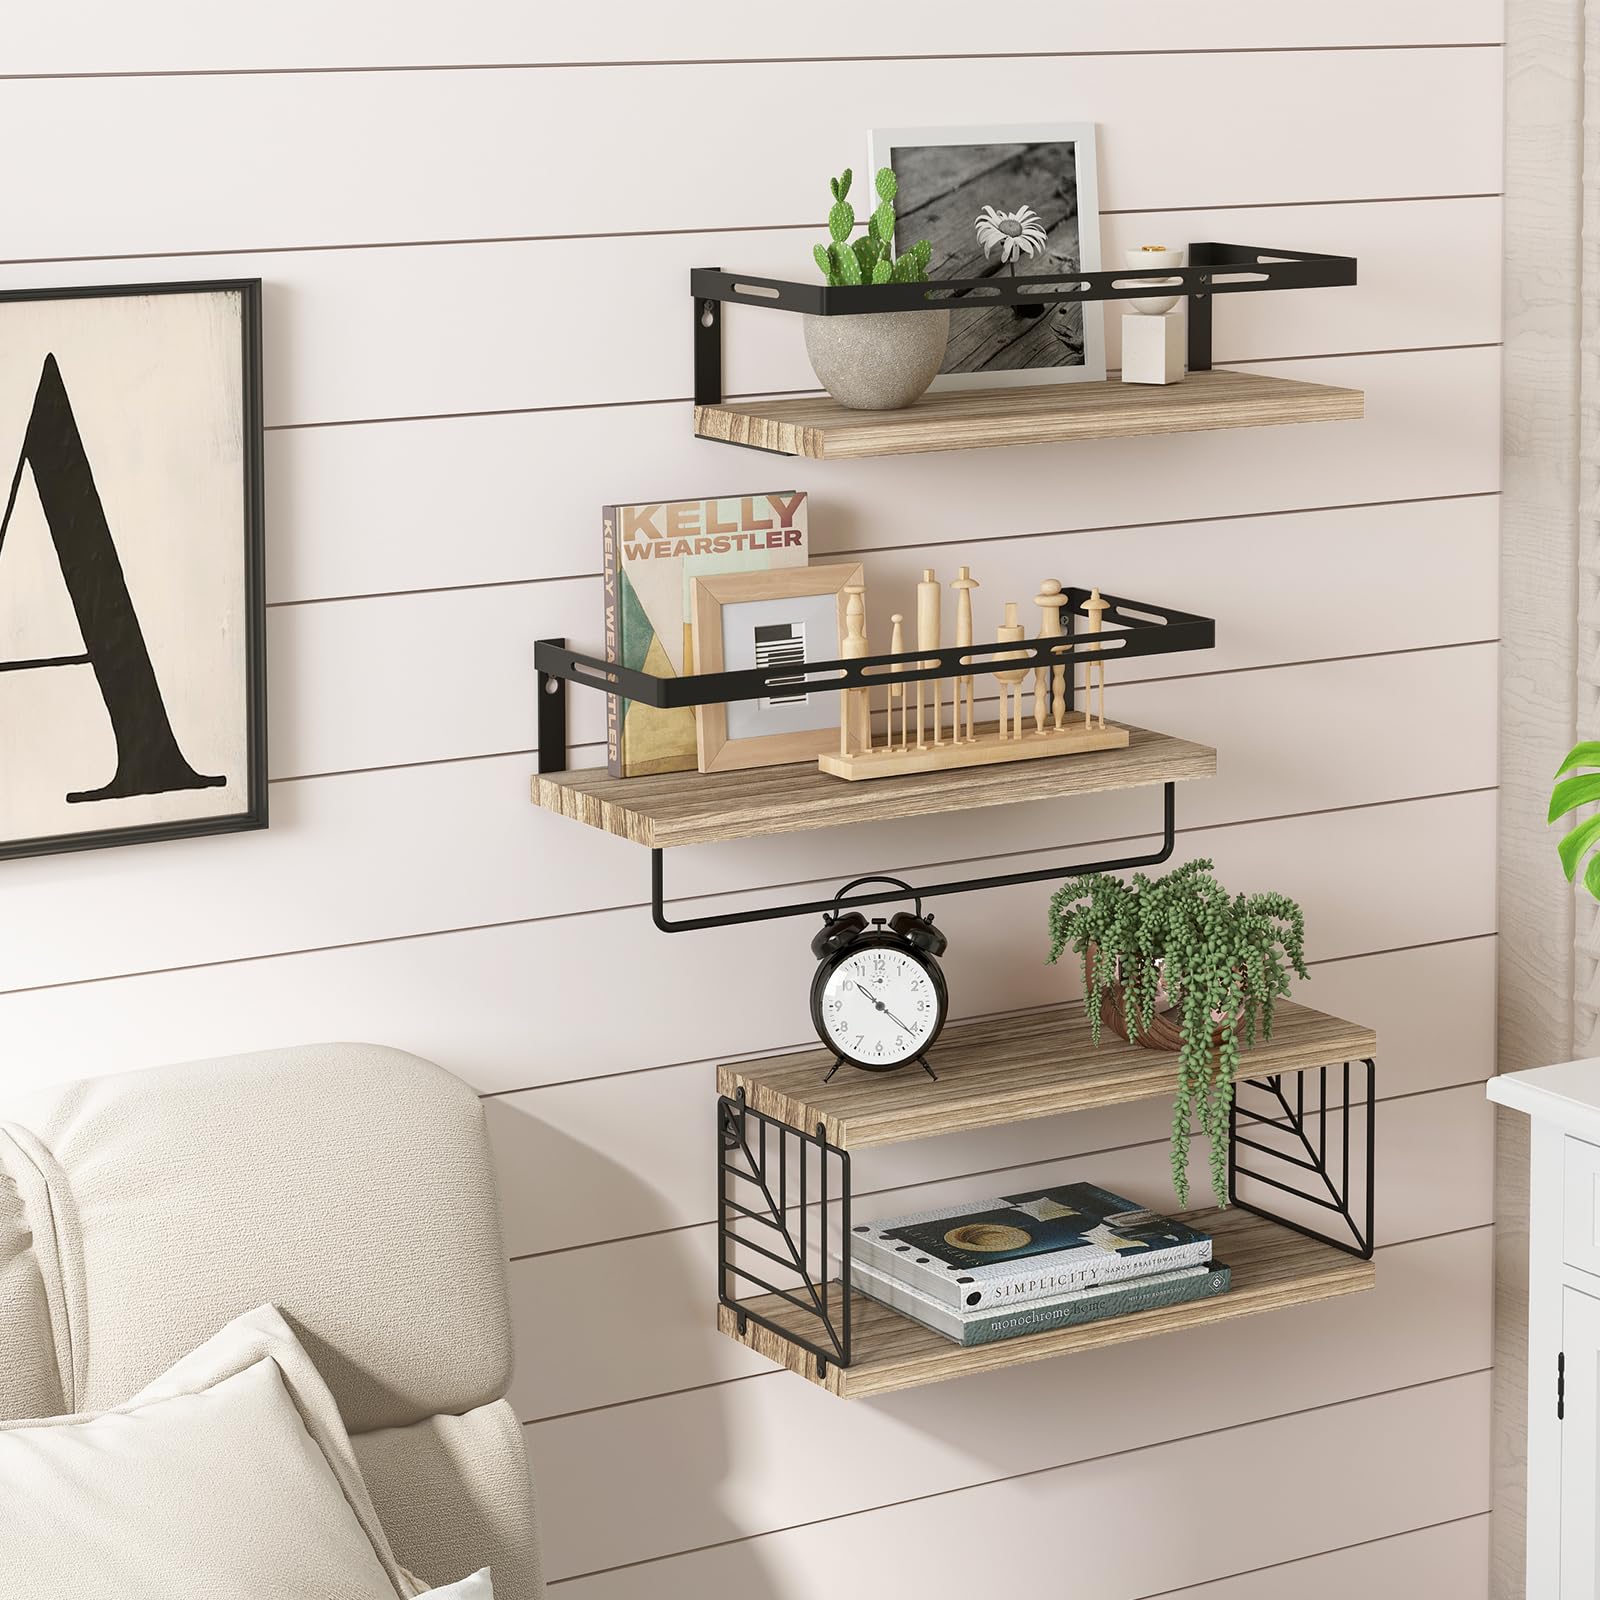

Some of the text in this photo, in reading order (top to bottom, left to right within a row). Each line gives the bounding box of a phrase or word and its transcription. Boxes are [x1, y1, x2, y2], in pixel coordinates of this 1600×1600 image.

[623, 491, 808, 542] KELLY
[623, 529, 803, 561] WEARSTLER
[604, 519, 614, 598] KELLY
[0, 351, 227, 804] A
[856, 966, 865, 976] 11
[873, 960, 885, 971] 12
[842, 980, 853, 991] 10
[911, 980, 919, 991] 2
[834, 1000, 843, 1012] 9
[917, 1000, 925, 1012] 3
[840, 1021, 848, 1032] 8
[909, 1021, 918, 1032] 4
[856, 1035, 864, 1047] 7
[875, 1040, 883, 1052] 6
[895, 1035, 903, 1046] 5
[995, 1268, 1099, 1298] SIMPLICITY
[1105, 1264, 1131, 1274] NANCY
[991, 1300, 1106, 1331] monochrome home
